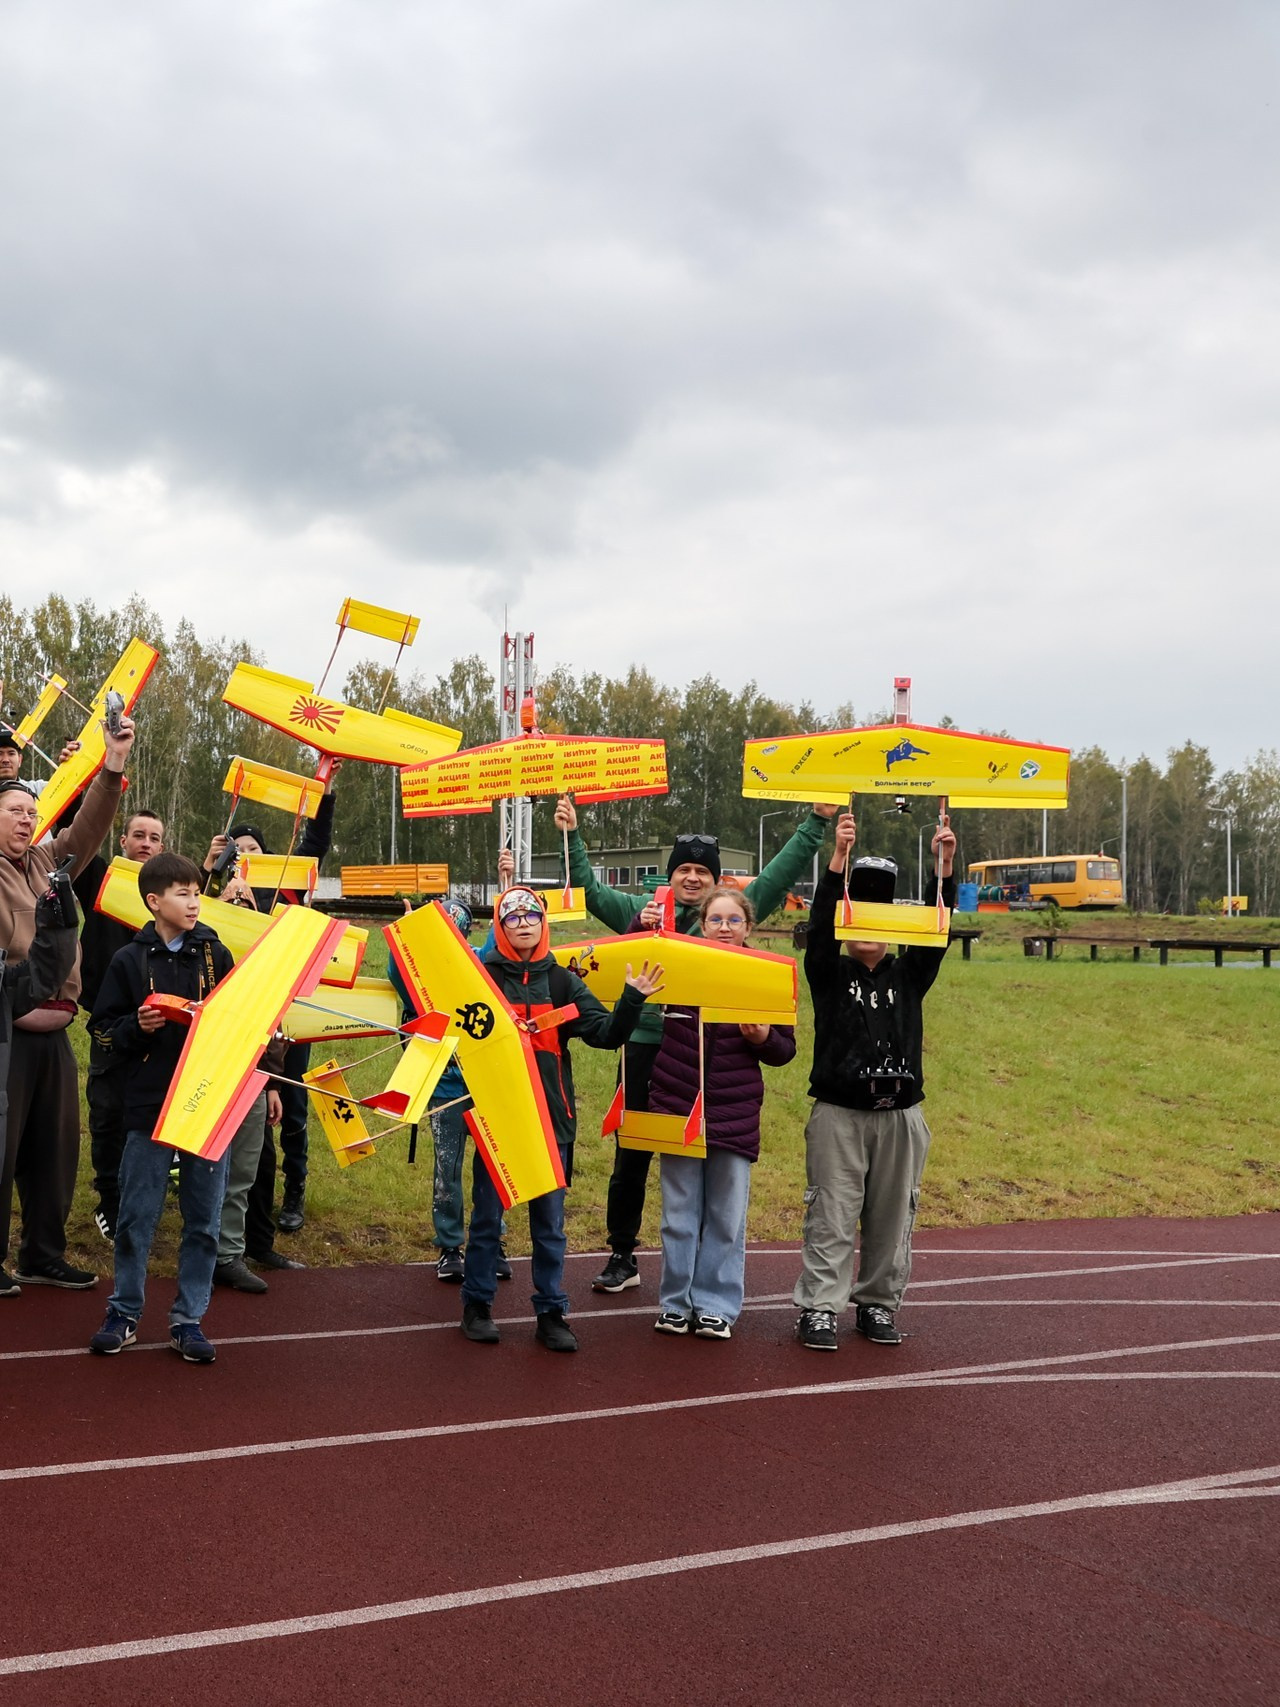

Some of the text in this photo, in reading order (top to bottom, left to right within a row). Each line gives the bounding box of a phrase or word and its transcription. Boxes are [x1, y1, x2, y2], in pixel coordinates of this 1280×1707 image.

[479, 757, 512, 766] АКЦИЯ!
[521, 753, 554, 762] АКЦИЯ!
[563, 748, 597, 758] АКЦИЯ!
[606, 744, 640, 753] АКЦИЯ!
[514, 742, 547, 751] АКЦИЯ!
[402, 789, 429, 798] КЦИЯ!
[437, 785, 470, 794] АКЦИЯ!
[478, 780, 511, 790] АКЦИЯ!
[520, 775, 553, 785] АКЦИЯ!
[562, 771, 596, 781] АКЦИЯ!
[605, 767, 640, 777] АКЦИЯ!
[403, 777, 429, 787] КЦИЯ!
[437, 773, 470, 783] АКЦИЯ!
[478, 769, 512, 778] АКЦИЯ!
[521, 764, 554, 774] АКЦИЯ!
[563, 760, 597, 769] АКЦИЯ!
[606, 755, 640, 765] АКЦИЯ!
[207, 965, 216, 987] NICE
[402, 943, 434, 1012] АКЦИЯ! ЦИЯ!
[479, 1115, 499, 1153] АКЦИЯ!
[499, 1162, 519, 1200] АКЦИЯ!
